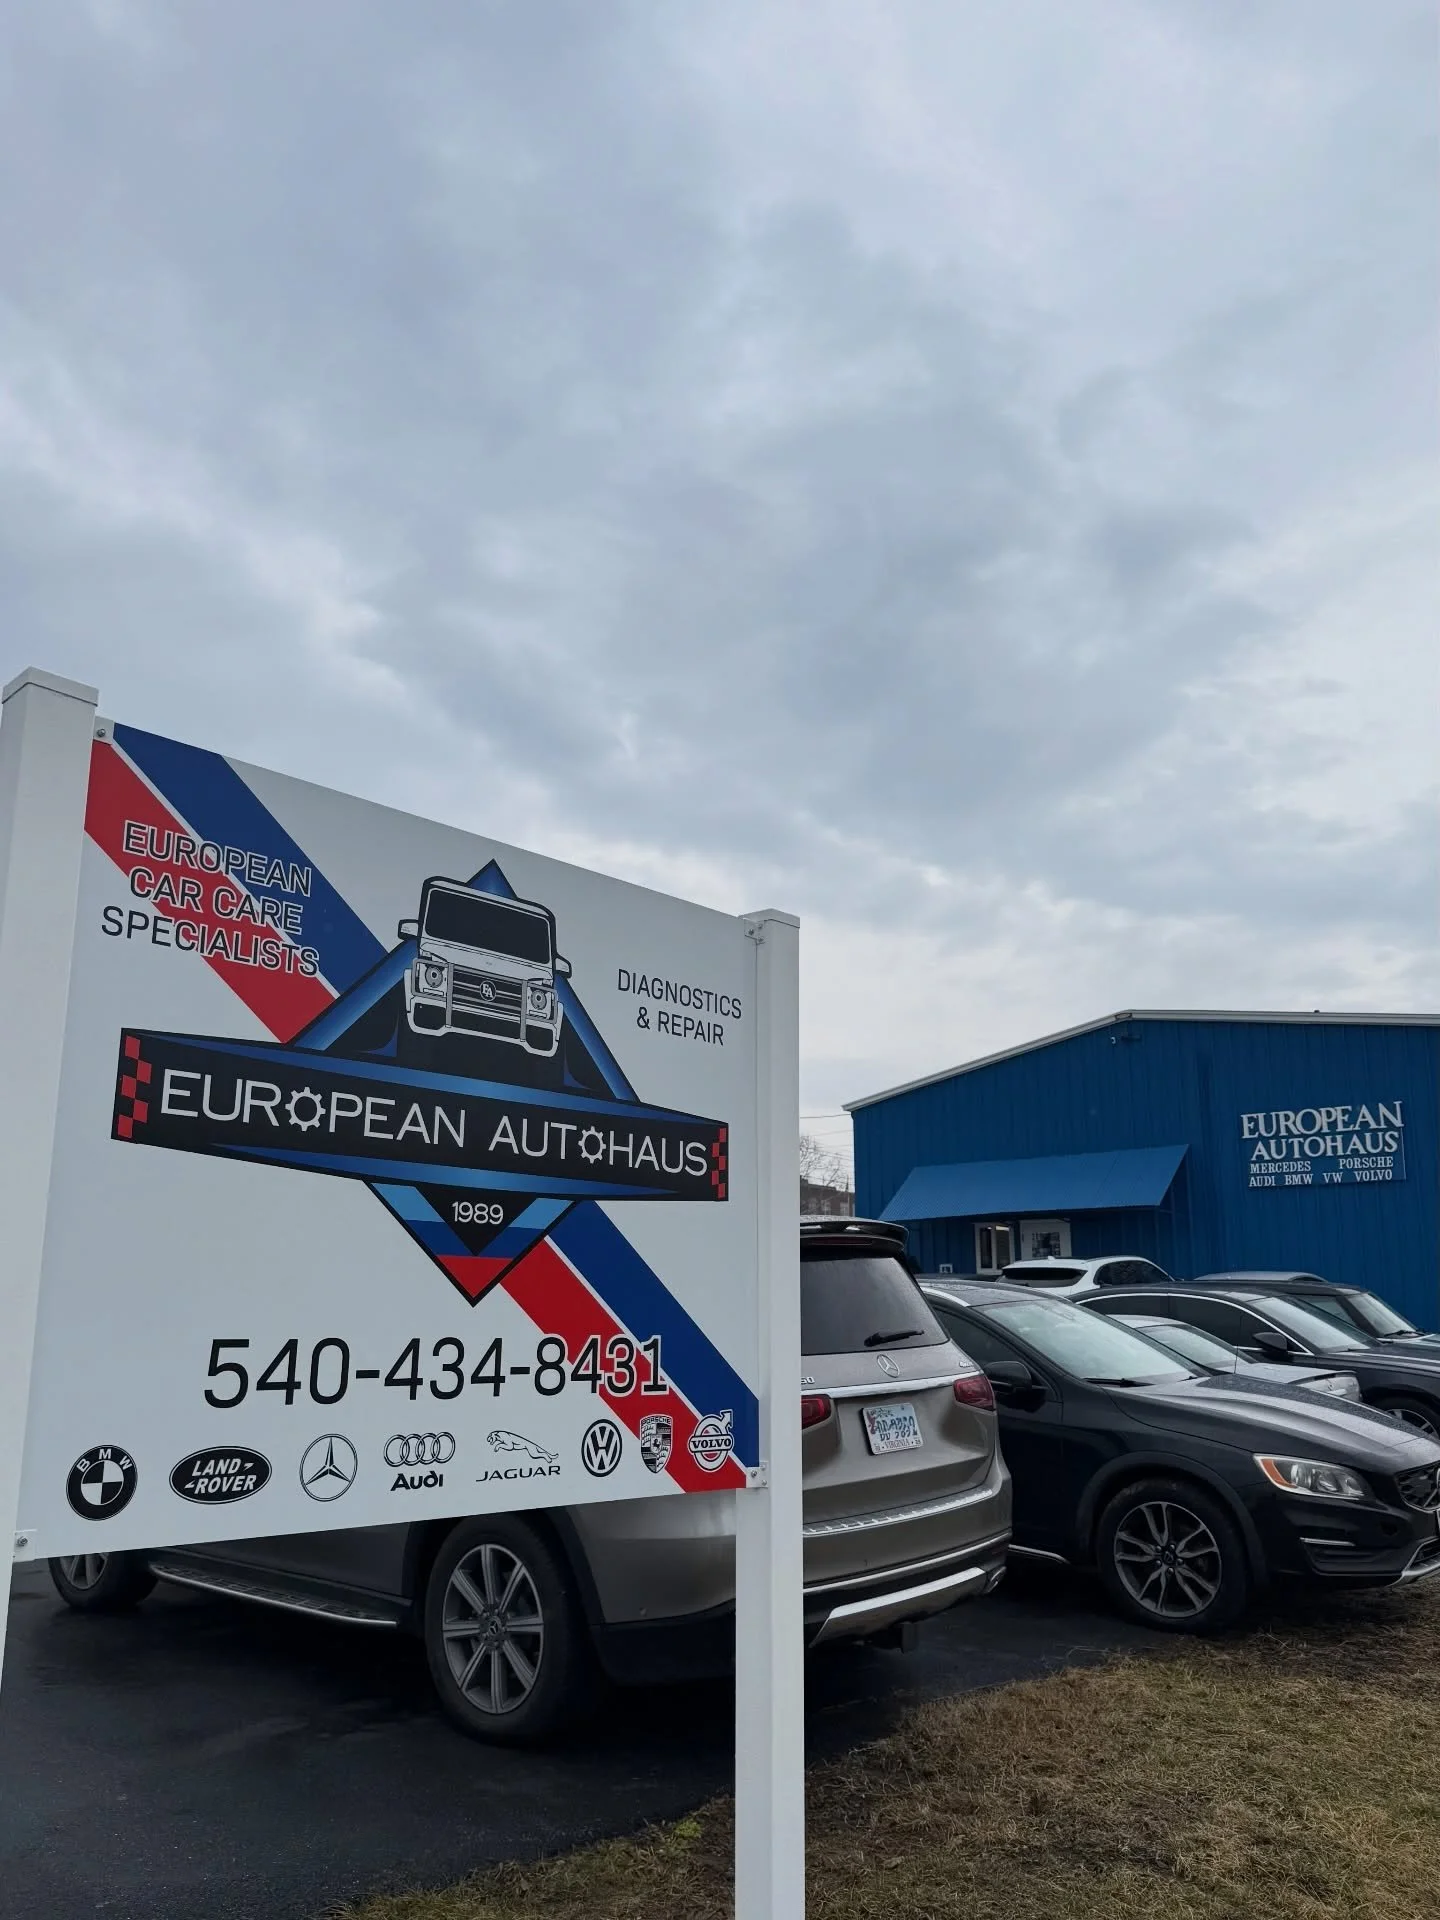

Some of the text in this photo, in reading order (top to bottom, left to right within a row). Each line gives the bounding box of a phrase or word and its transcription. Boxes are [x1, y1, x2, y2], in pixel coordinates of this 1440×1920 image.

[122, 820, 312, 897] EUROPEAN
[129, 867, 303, 935] CAR CARE
[101, 905, 320, 977] SPECIALISTS
[617, 968, 743, 1020] DIAGNOSTICS
[636, 1006, 725, 1046] & REPAIR
[1240, 1100, 1405, 1139] EUROPEAN
[1251, 1131, 1400, 1161] AUTOHAUS
[1249, 1169, 1393, 1188] AUDI BMW VW VOLVO
[1250, 1156, 1394, 1174] MERCEDES PORSCHE
[451, 1201, 504, 1226] 1989
[204, 1334, 669, 1409] 540-434-8431
[691, 1438, 731, 1449] VOLVO
[191, 1457, 240, 1477] LAND
[475, 1465, 561, 1482] JAGUAR
[195, 1474, 257, 1495] ROVER
